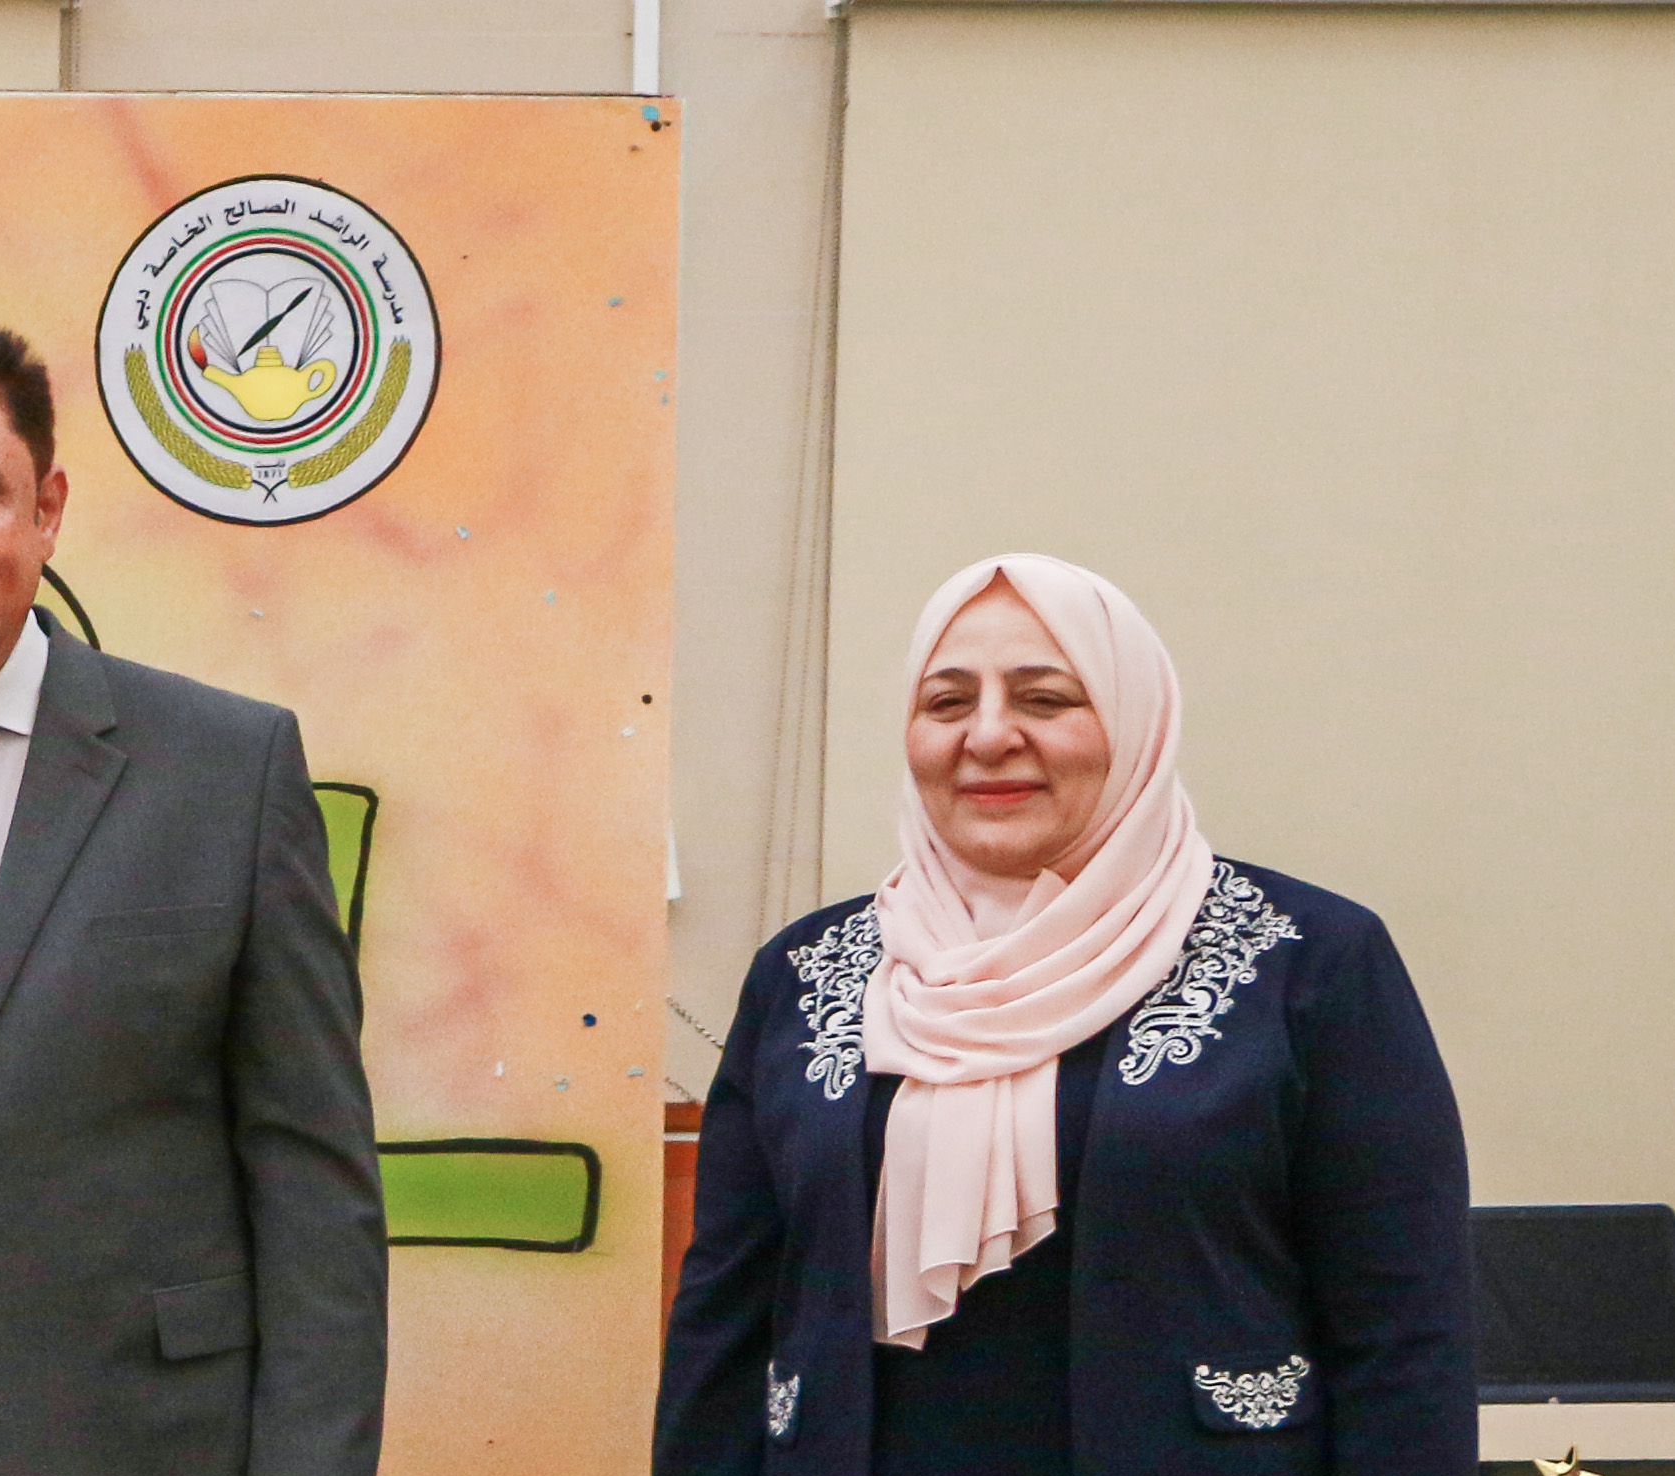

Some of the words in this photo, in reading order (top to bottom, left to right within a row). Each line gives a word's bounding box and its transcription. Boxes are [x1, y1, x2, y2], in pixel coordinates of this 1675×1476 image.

[224, 198, 296, 226] الصالح
[308, 207, 370, 251] الراشد
[143, 213, 213, 278] الخاصة
[136, 289, 151, 330] دبي
[371, 253, 404, 325] مدرسة
